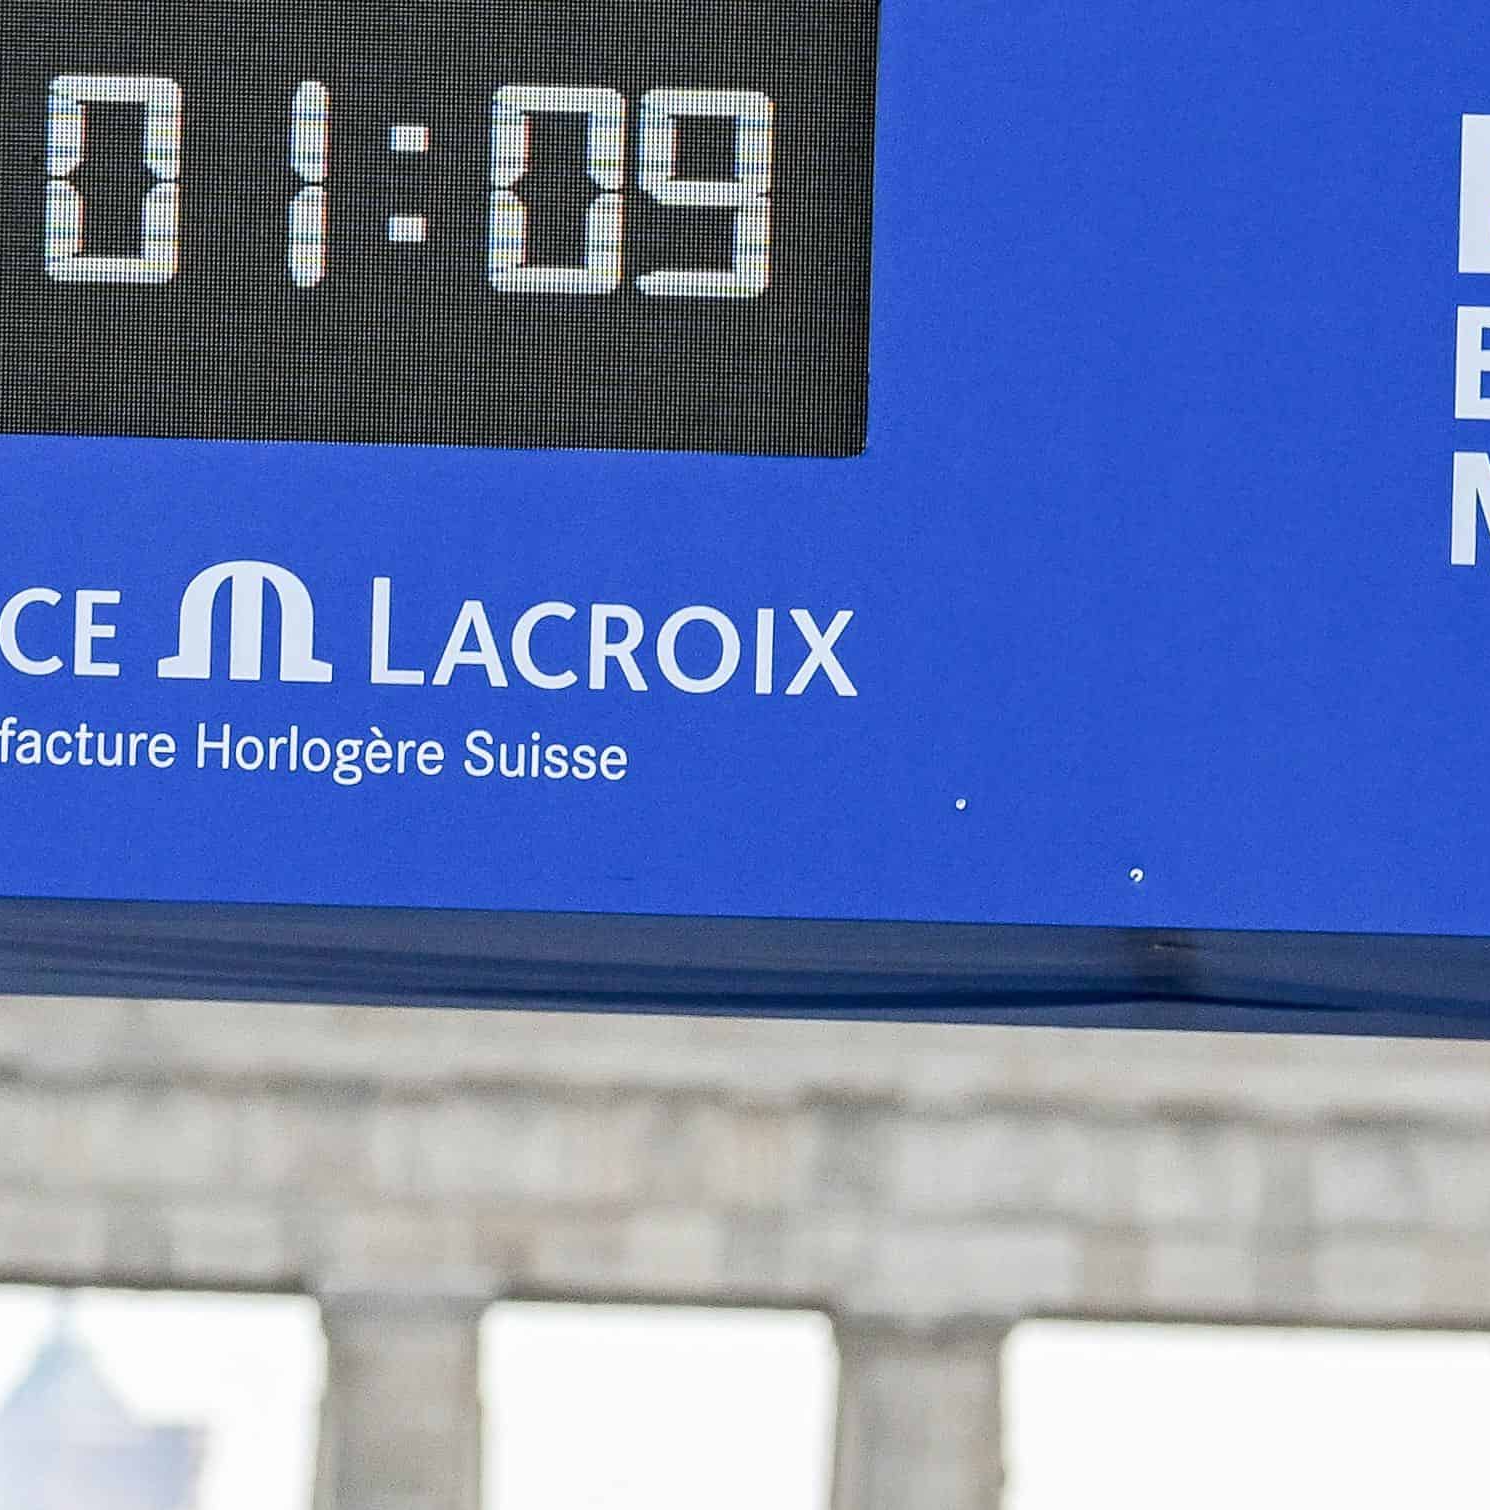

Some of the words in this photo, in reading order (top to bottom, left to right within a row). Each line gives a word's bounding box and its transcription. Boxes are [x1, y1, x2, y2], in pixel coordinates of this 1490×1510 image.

[369, 576, 859, 698] LACROIX
[195, 722, 446, 787] Horlogère
[462, 729, 630, 782] Suisse
